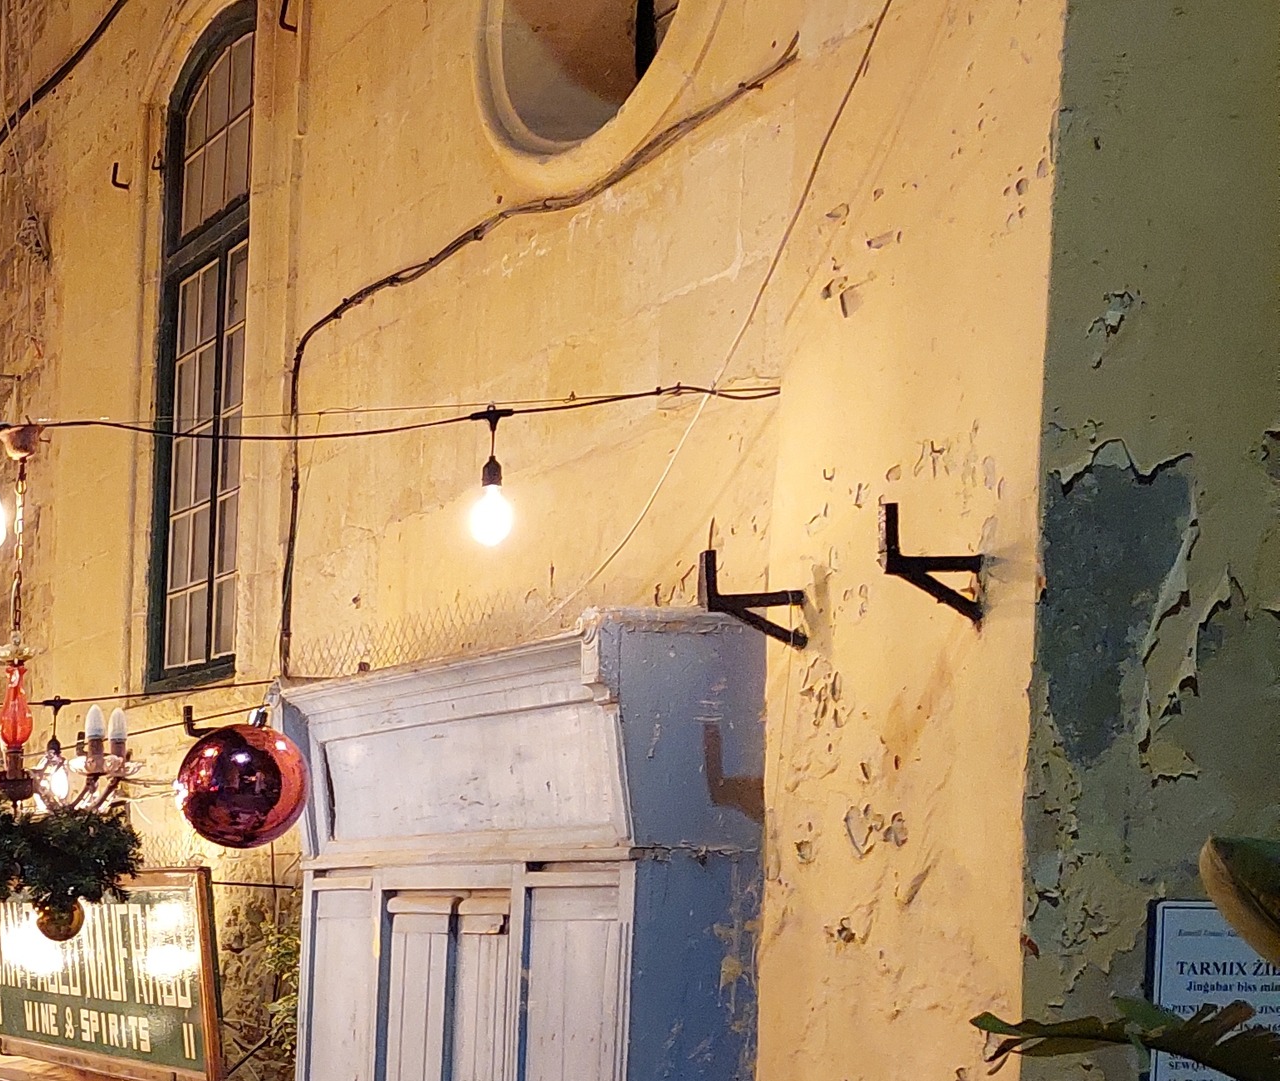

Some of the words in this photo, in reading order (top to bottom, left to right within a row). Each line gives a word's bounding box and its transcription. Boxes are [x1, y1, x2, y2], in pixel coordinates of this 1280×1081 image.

[22, 902, 82, 997] PLO
[1176, 960, 1247, 976] TARMIX
[23, 999, 60, 1037] VINE
[64, 1006, 75, 1040] &
[79, 1007, 152, 1053] SPIRITS
